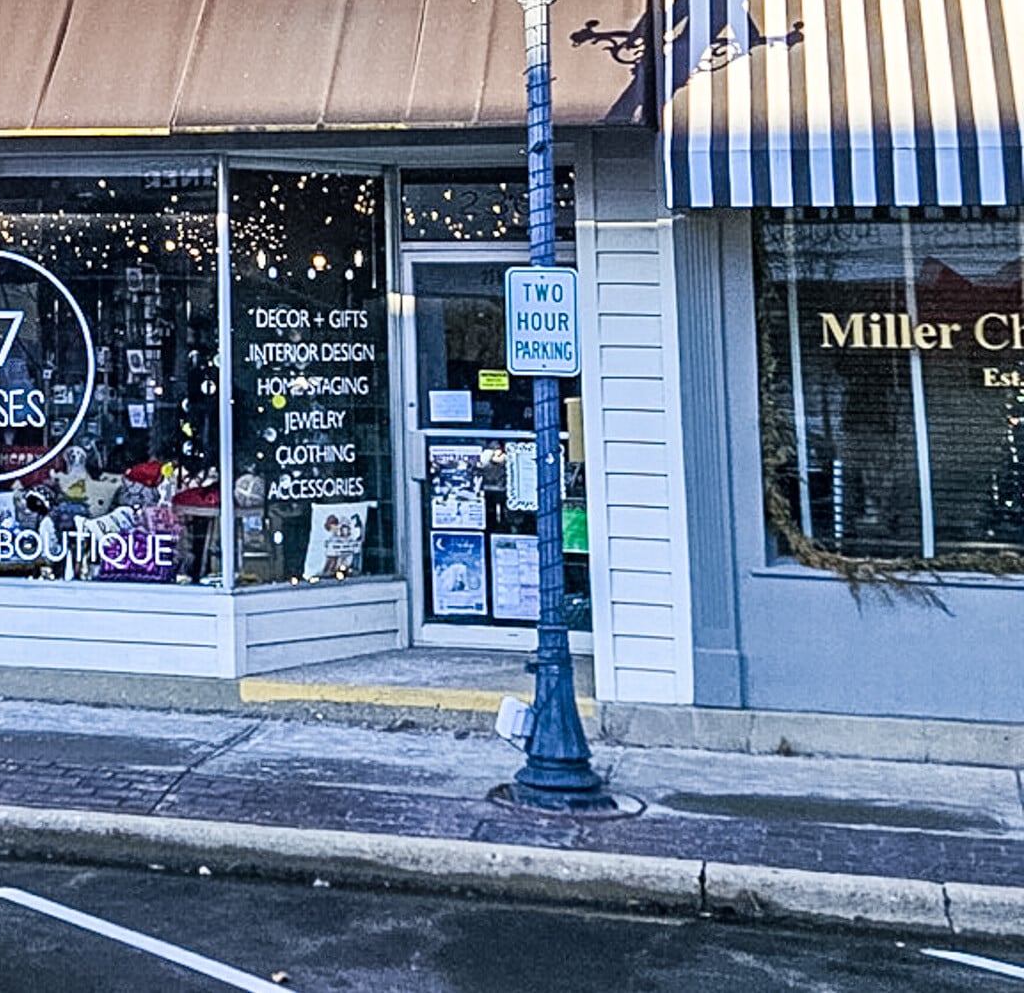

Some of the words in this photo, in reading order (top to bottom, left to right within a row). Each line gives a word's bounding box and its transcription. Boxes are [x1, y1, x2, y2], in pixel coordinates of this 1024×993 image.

[522, 283, 563, 303] TWO
[256, 309, 311, 328] DECOR
[313, 312, 325, 327] +
[328, 310, 368, 328] GIFTS
[517, 311, 569, 332] HOUR
[819, 313, 962, 350] Miller
[249, 343, 319, 362] INTERIOR
[321, 343, 375, 362] DESIGN
[516, 340, 572, 361] PARKING
[284, 410, 346, 435] JEWELRY
[275, 444, 356, 465] CLOTHING
[267, 477, 364, 500] ACCESSORIES
